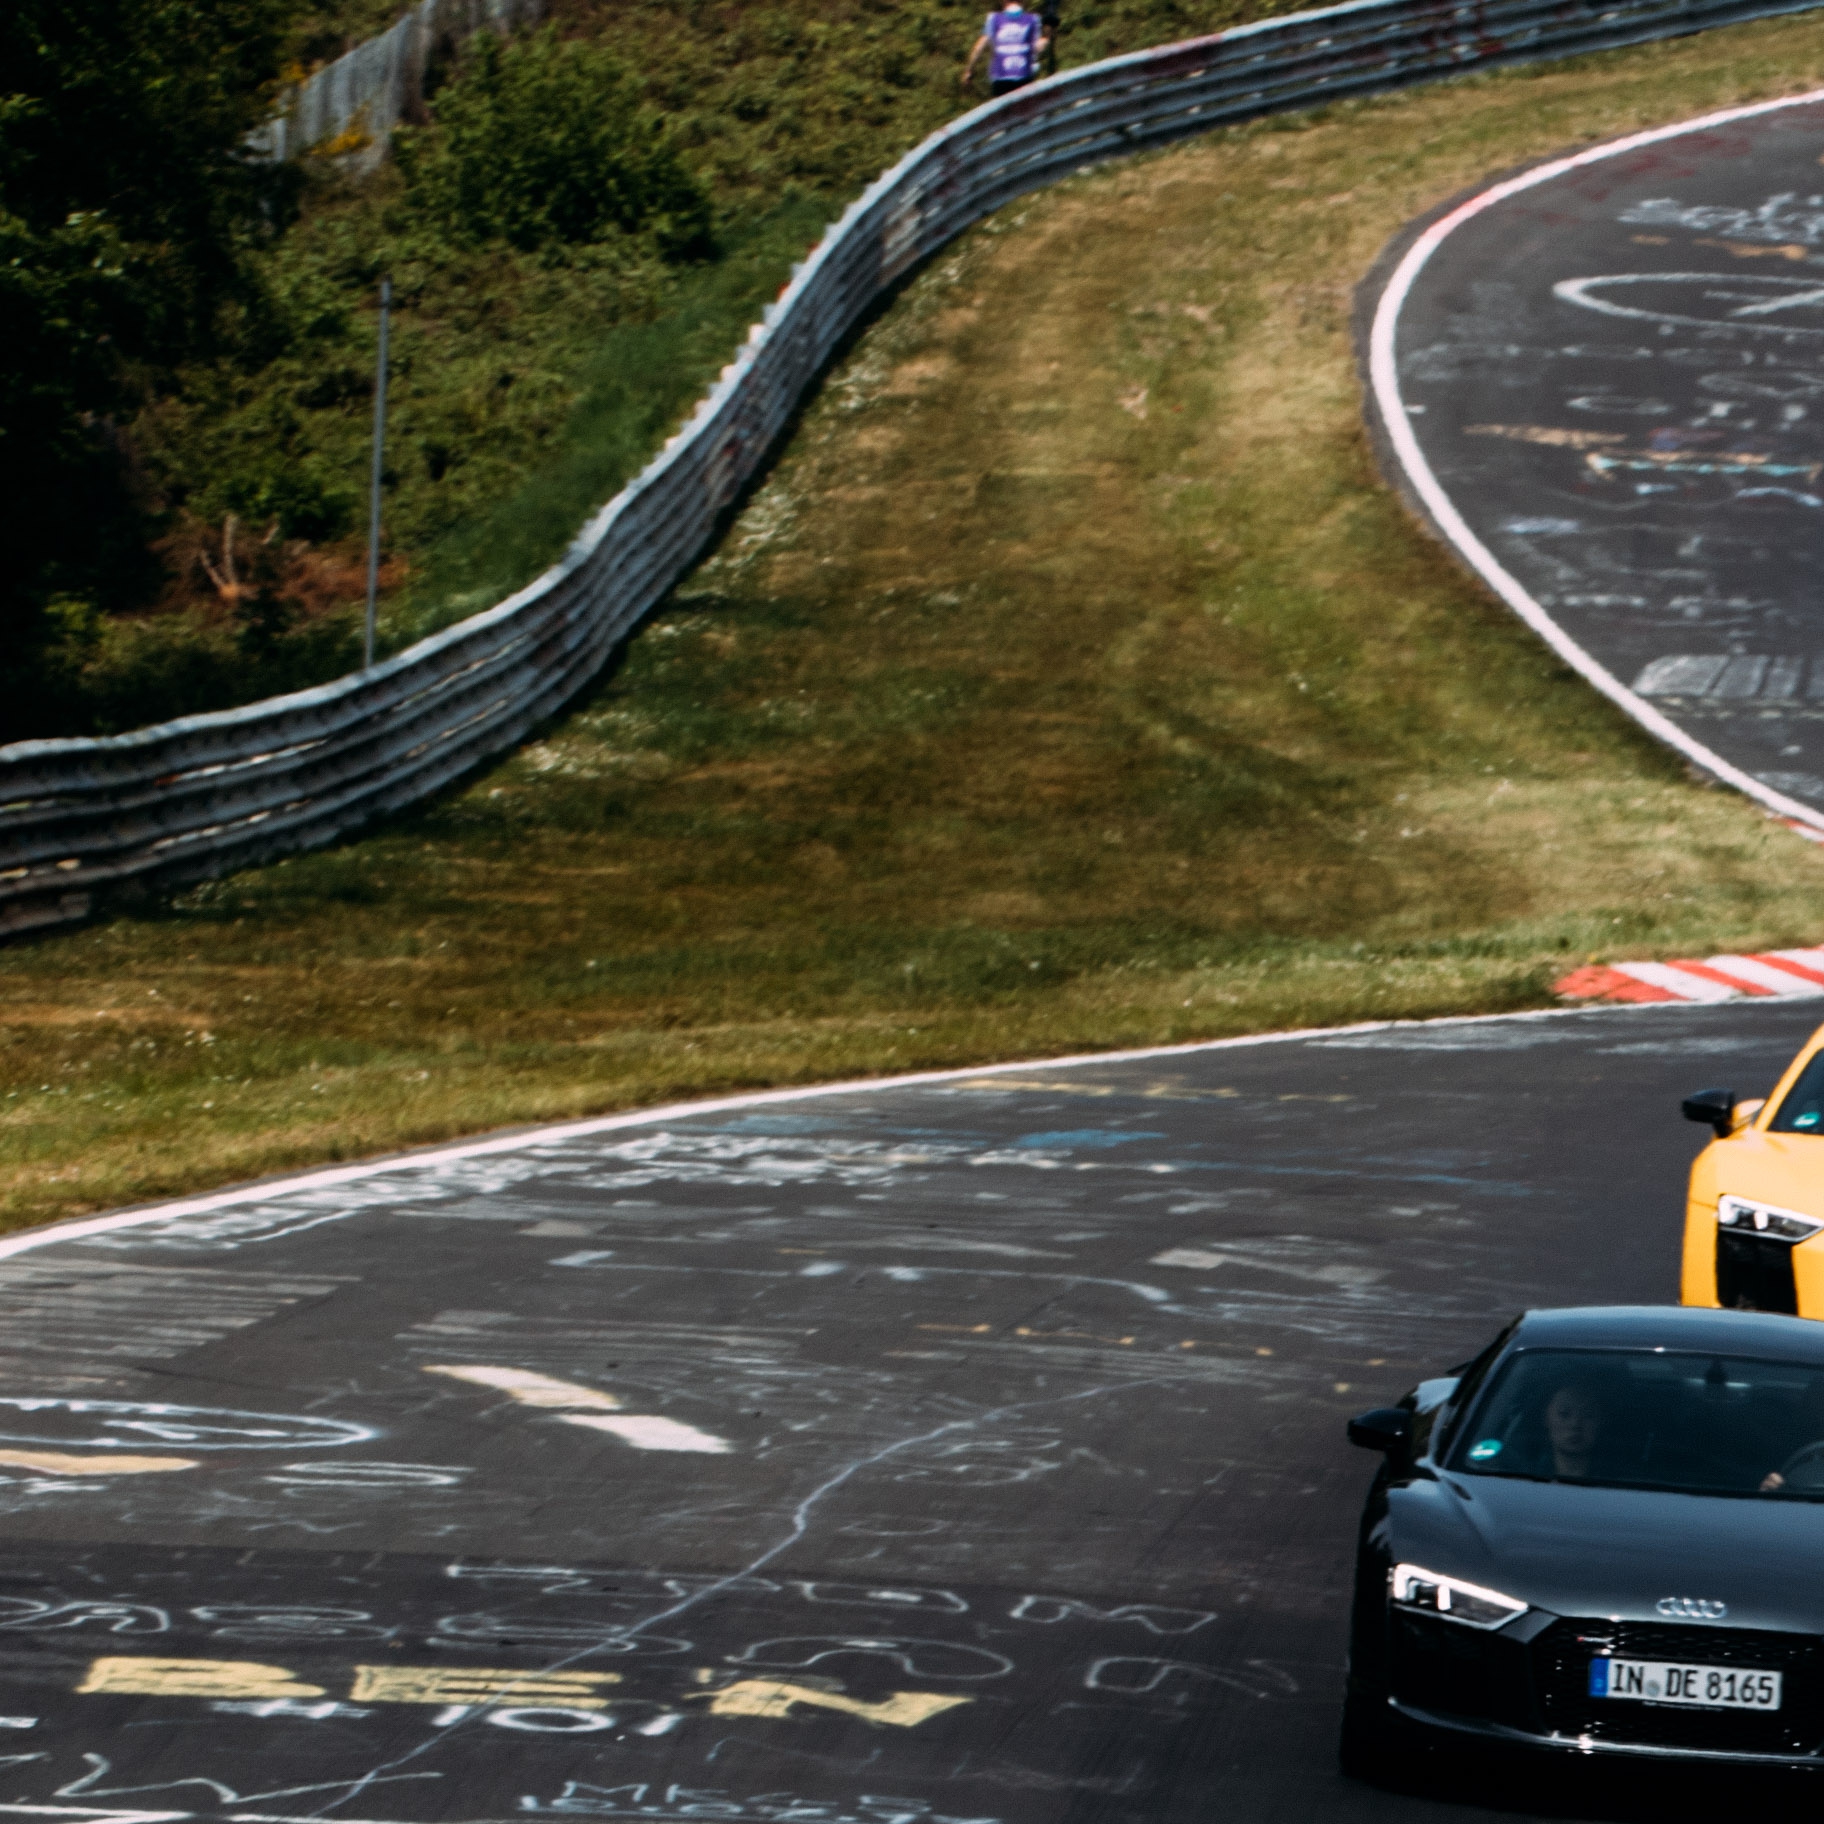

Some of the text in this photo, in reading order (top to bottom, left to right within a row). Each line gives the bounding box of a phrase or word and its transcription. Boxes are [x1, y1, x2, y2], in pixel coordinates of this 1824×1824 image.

[1612, 1664, 1774, 1705] IN DE 8165
